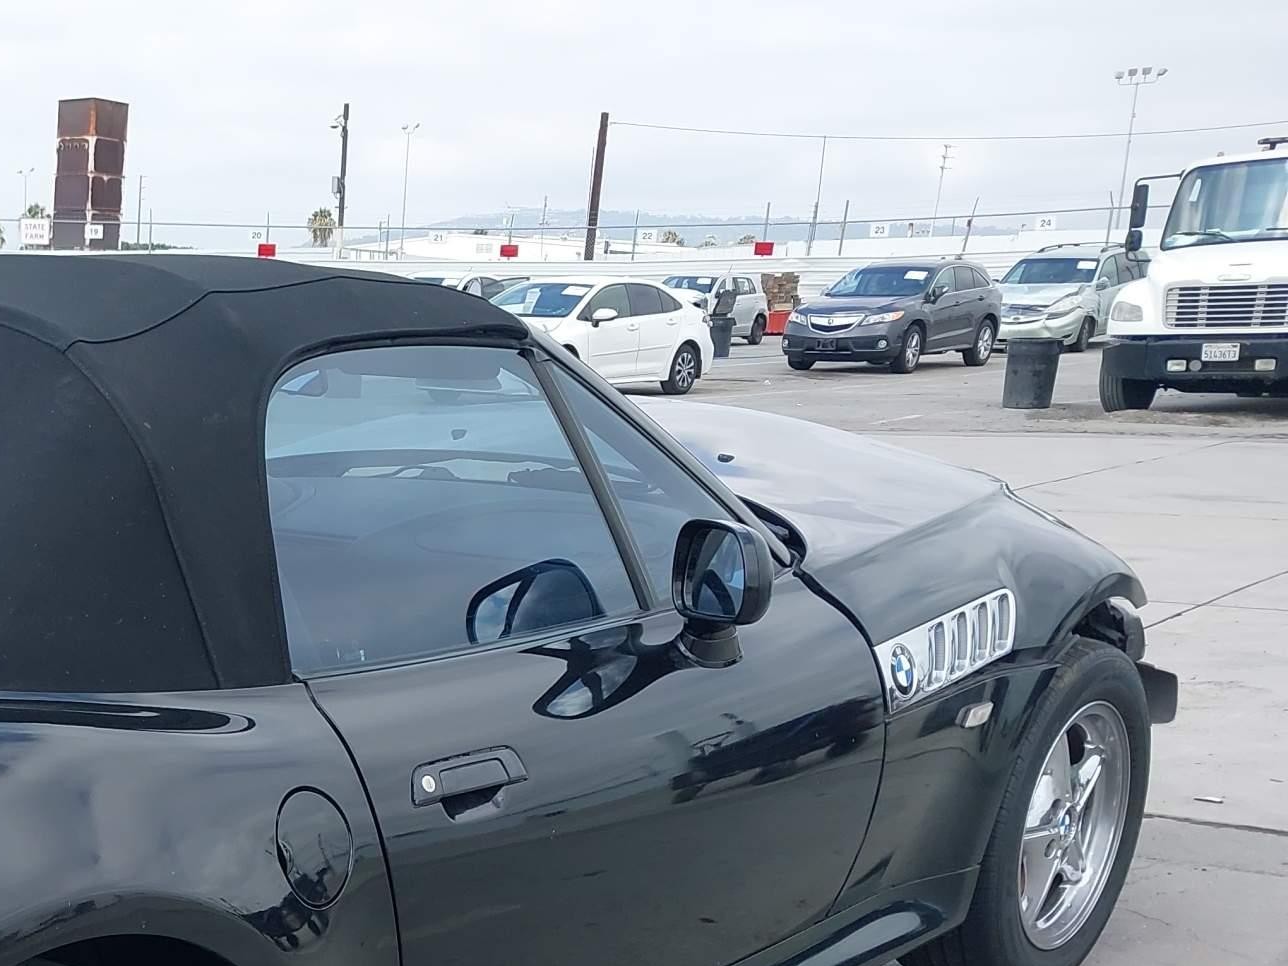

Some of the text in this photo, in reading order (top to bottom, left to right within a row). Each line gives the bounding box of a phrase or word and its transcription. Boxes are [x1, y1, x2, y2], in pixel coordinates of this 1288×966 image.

[24, 223, 46, 231] STATE
[1040, 219, 1052, 228] 24
[90, 228, 99, 236] 19
[874, 225, 885, 235] 23
[251, 231, 262, 240] 20
[433, 233, 443, 242] 21
[642, 231, 653, 240] 22
